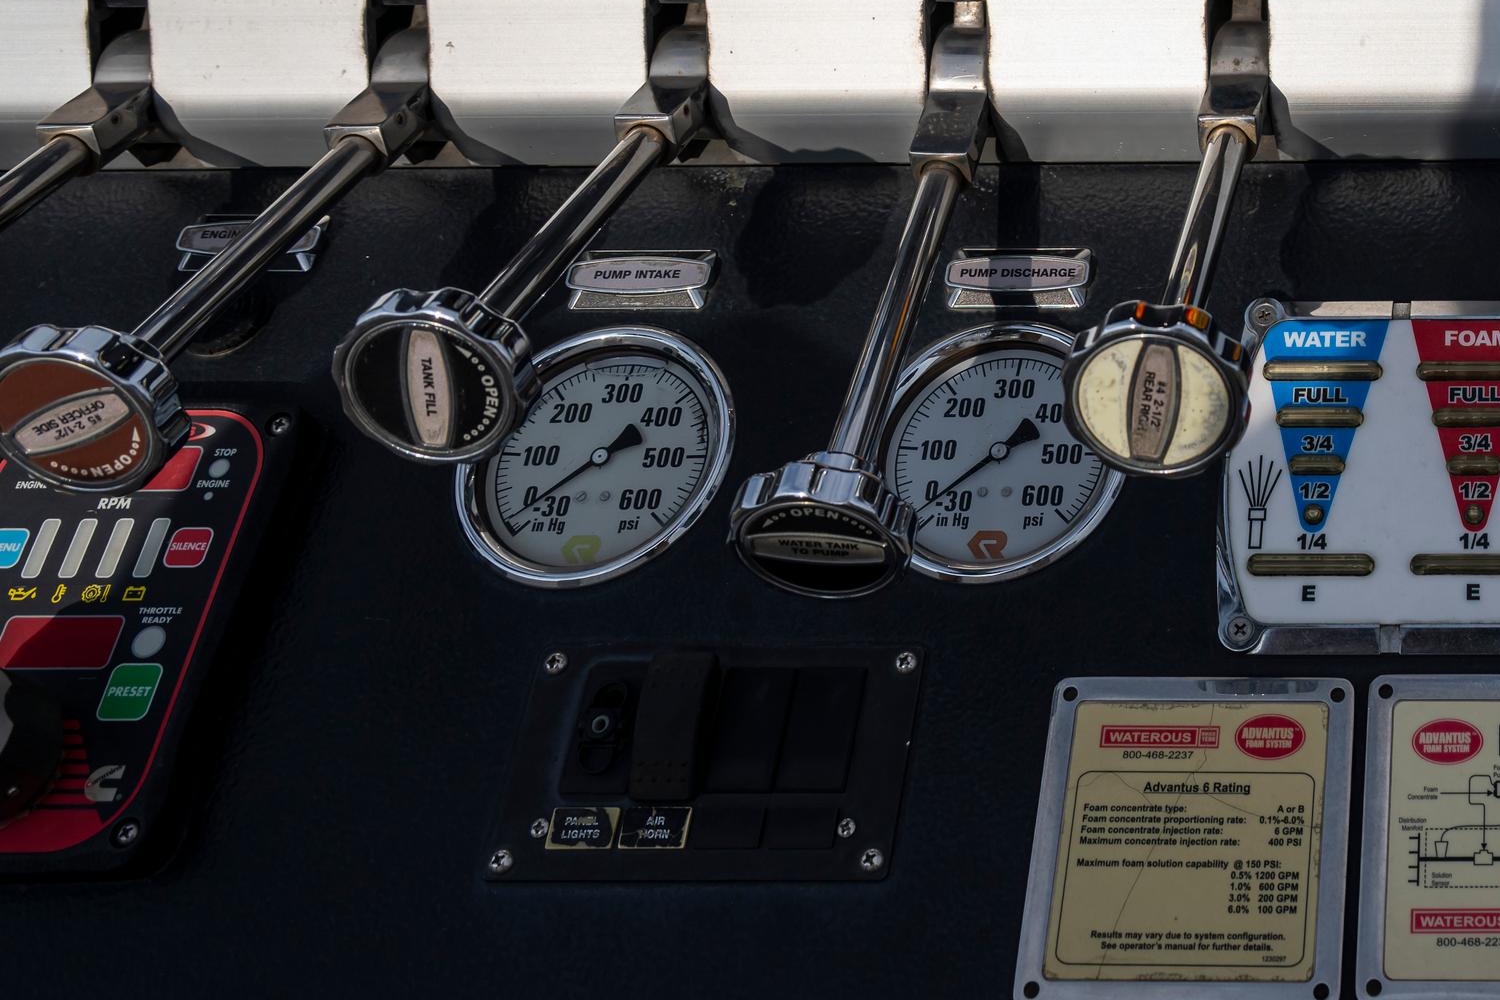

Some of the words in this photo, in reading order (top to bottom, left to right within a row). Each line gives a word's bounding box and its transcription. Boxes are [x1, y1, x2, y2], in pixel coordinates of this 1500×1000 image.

[594, 270, 632, 280] PUMP
[634, 270, 680, 280] INTAKE
[960, 268, 998, 278] PUMP
[1000, 268, 1076, 278] DISCHARGE
[1283, 330, 1368, 348] WATER
[420, 357, 434, 390] TANK
[480, 374, 500, 418] OPEN
[602, 384, 642, 403] 300
[1293, 387, 1347, 402] FULL
[424, 392, 438, 416] FILL
[550, 403, 592, 424] 200
[640, 407, 682, 427] 400
[1301, 435, 1334, 452] 3/4
[1458, 435, 1492, 452] 3/4
[214, 448, 238, 457] STOP
[524, 446, 560, 466] 100
[642, 448, 684, 468] 500
[196, 480, 230, 488] ENGINE
[1300, 483, 1330, 499] 1/2
[1460, 482, 1492, 499] 1/2
[97, 498, 132, 510] RPM
[533, 496, 570, 517] -30
[619, 489, 662, 510] 600
[790, 508, 839, 520] OPEN
[531, 518, 546, 532] in
[548, 518, 566, 534] Hg
[618, 517, 640, 534] psi
[170, 541, 208, 551] SILENCE
[778, 540, 822, 548] WATER
[826, 542, 860, 550] TANK
[1297, 534, 1328, 550] 1/4
[1459, 534, 1490, 550] 1/4
[812, 548, 849, 556] PUMP
[1302, 585, 1316, 602] E
[1466, 584, 1480, 600] E
[138, 606, 184, 616] THROTTLE
[141, 616, 174, 624] READY
[107, 686, 152, 697] PRESET
[1110, 731, 1192, 744] WATEROUS
[1420, 732, 1472, 744] ADVANTUS
[1122, 750, 1194, 760] 800-468-2237
[1144, 782, 1200, 793] Advantus
[1203, 782, 1210, 793] 6
[1213, 782, 1251, 795] Rating
[1084, 804, 1108, 812] Foam
[1110, 804, 1163, 812] concentrate
[1165, 805, 1188, 814] type:
[646, 816, 666, 826] AIR
[560, 829, 600, 839] LIGHTS
